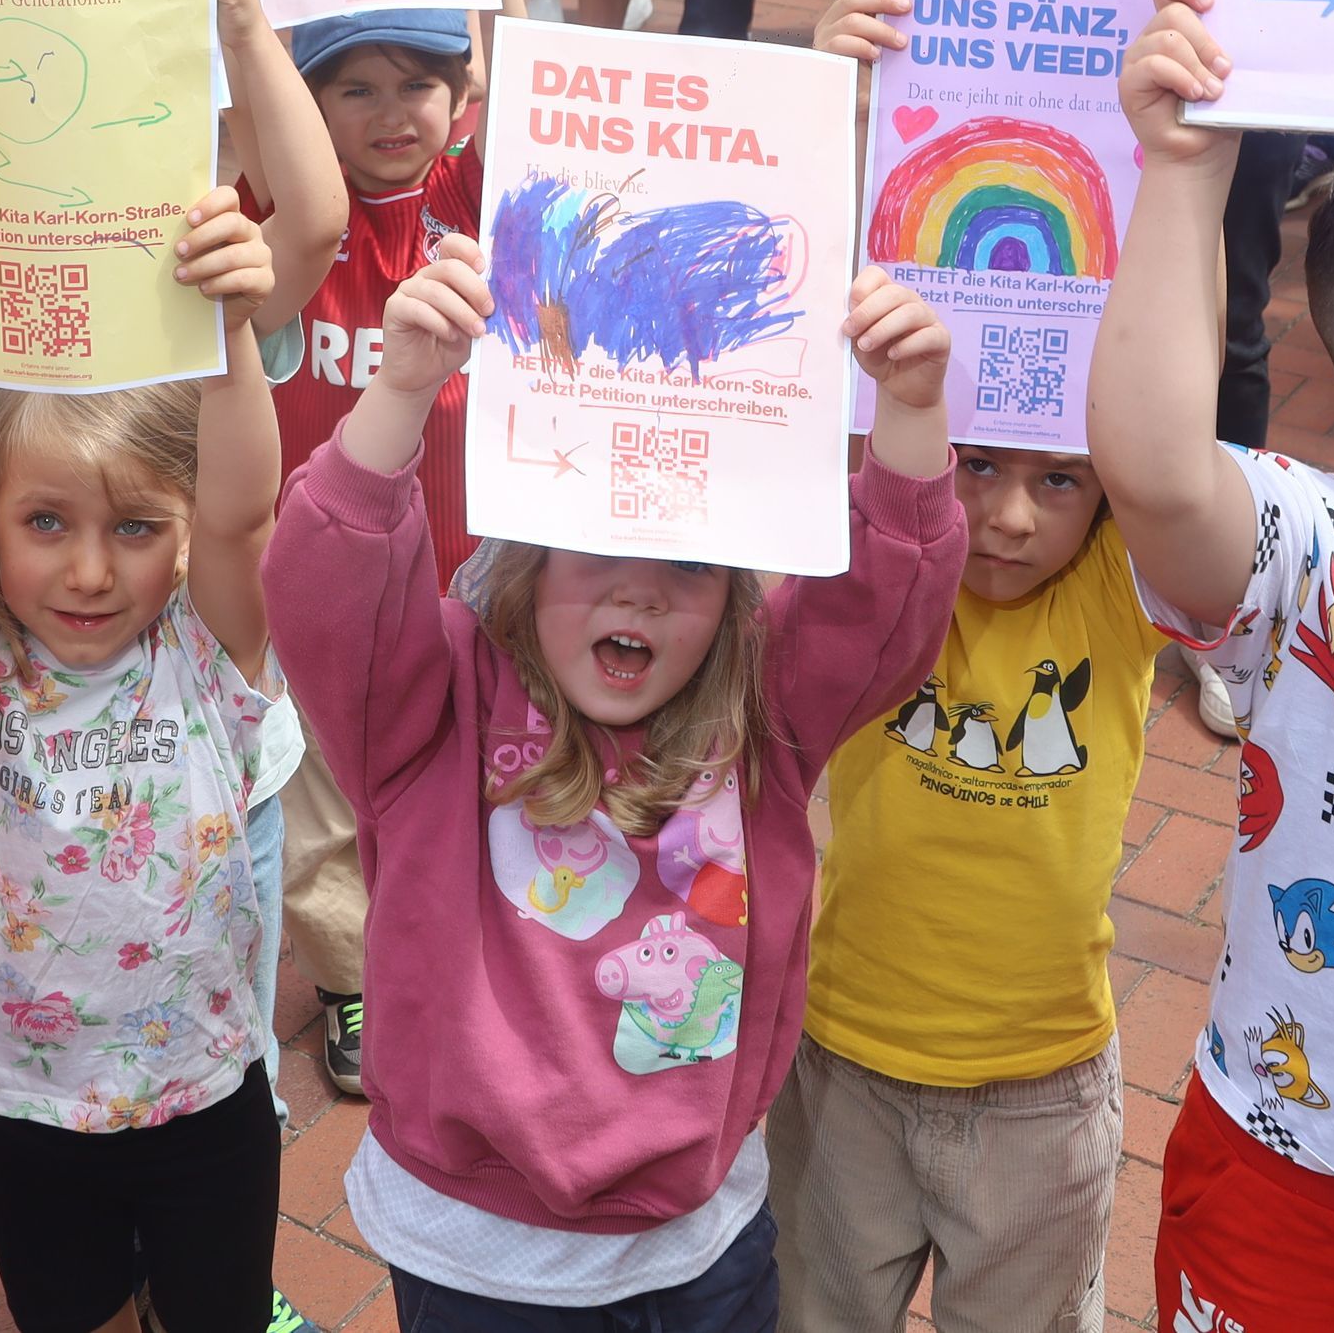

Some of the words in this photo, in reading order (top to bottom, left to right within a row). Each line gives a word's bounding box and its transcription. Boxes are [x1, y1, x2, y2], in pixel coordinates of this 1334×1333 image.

[911, 34, 994, 70] UNS
[1005, 41, 1123, 77] VEED
[532, 60, 632, 105] DAT
[643, 72, 709, 112] ES
[907, 82, 933, 101] Dat
[939, 89, 962, 103] ene
[966, 88, 999, 107] jeiht
[1004, 90, 1024, 107] nit
[1029, 93, 1064, 109] ohne
[1068, 93, 1091, 111] dat
[529, 108, 634, 154] UNS
[648, 121, 778, 167] KITA.
[555, 169, 579, 188] die
[584, 172, 621, 192] bliev
[311, 318, 384, 389] RE
[33, 719, 179, 773] ANGEES
[0, 766, 65, 814] GIRLS
[920, 773, 996, 805] PINGÜINOS
[1000, 797, 1013, 807] DE
[1017, 795, 1049, 808] CHILE
[960, 776, 1017, 791] saltarrocas
[1024, 779, 1073, 793] emperador
